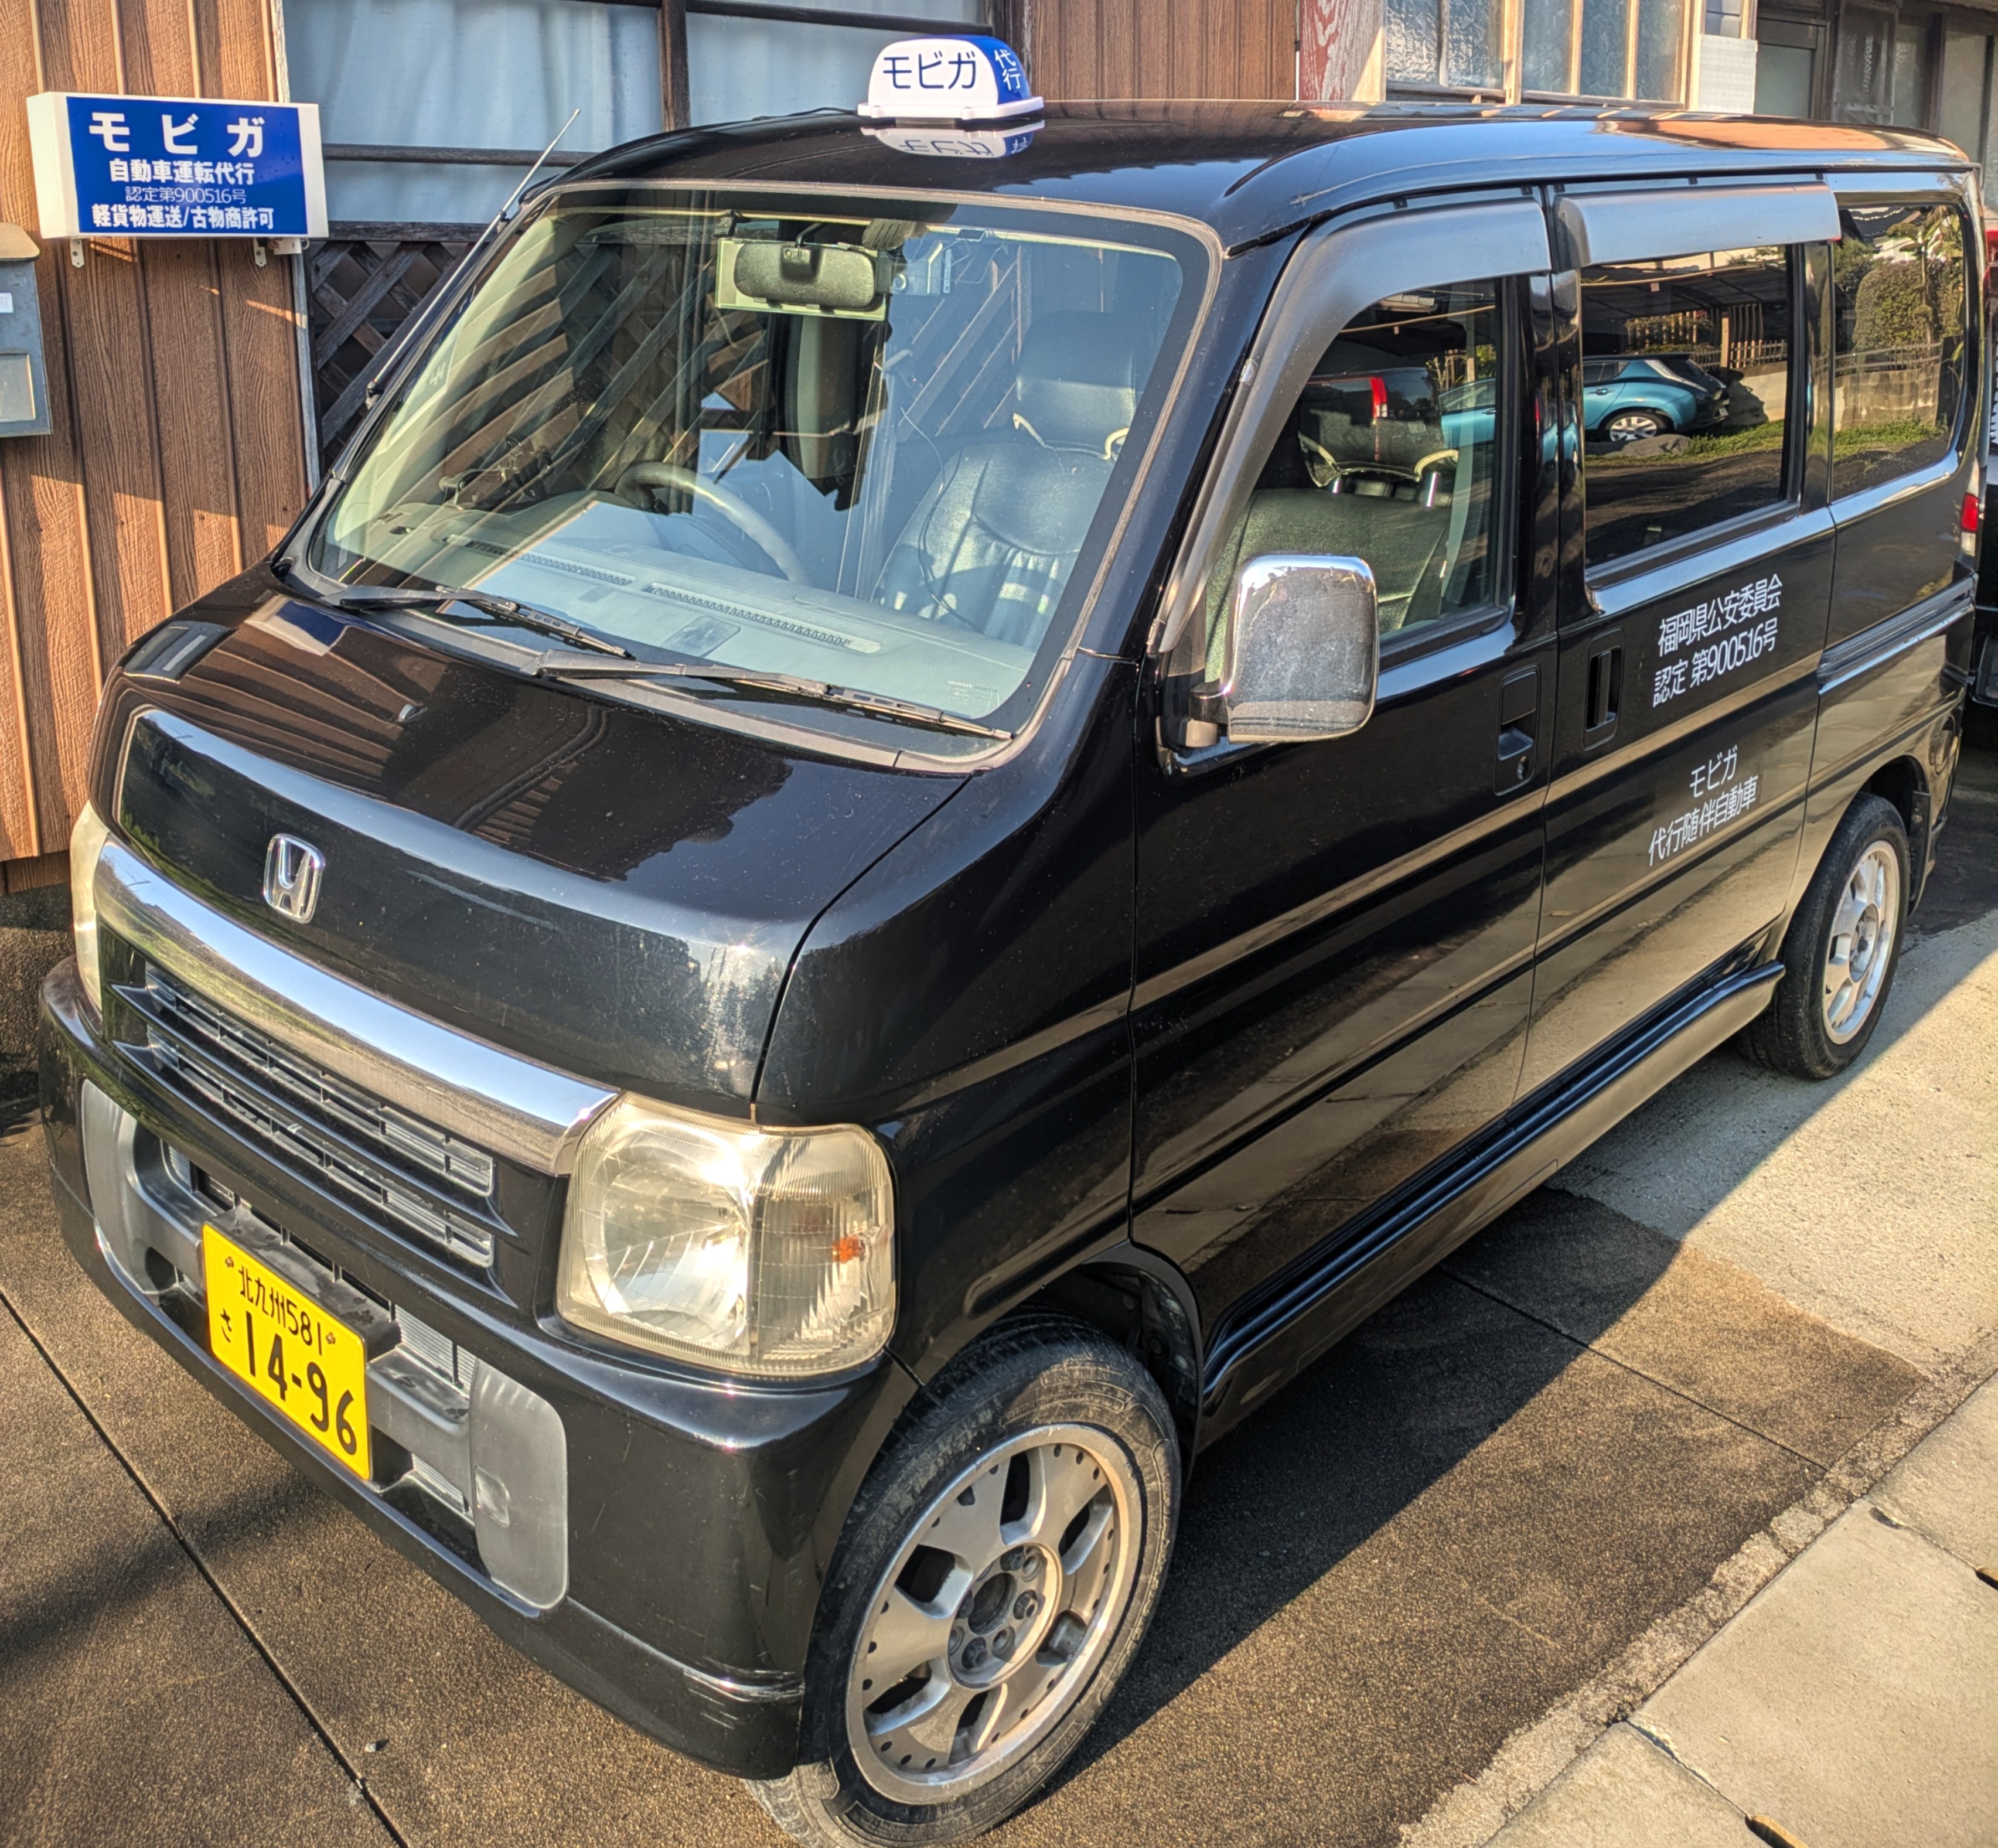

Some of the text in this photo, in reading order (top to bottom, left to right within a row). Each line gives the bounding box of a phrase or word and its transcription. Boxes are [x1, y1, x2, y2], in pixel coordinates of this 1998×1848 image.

[883, 50, 976, 89] モビガ
[994, 49, 1021, 91] 代行
[109, 158, 255, 185] 自動車運転代行
[125, 186, 247, 204] 認定第900516号
[92, 204, 274, 229] 軽貨物運送/古物商許可
[1658, 574, 1782, 657] 福岡県公安委員会
[1689, 745, 1738, 798] モビガ
[1648, 776, 1758, 867] 代行随伴自動車
[220, 1307, 357, 1455] さ 14-96
